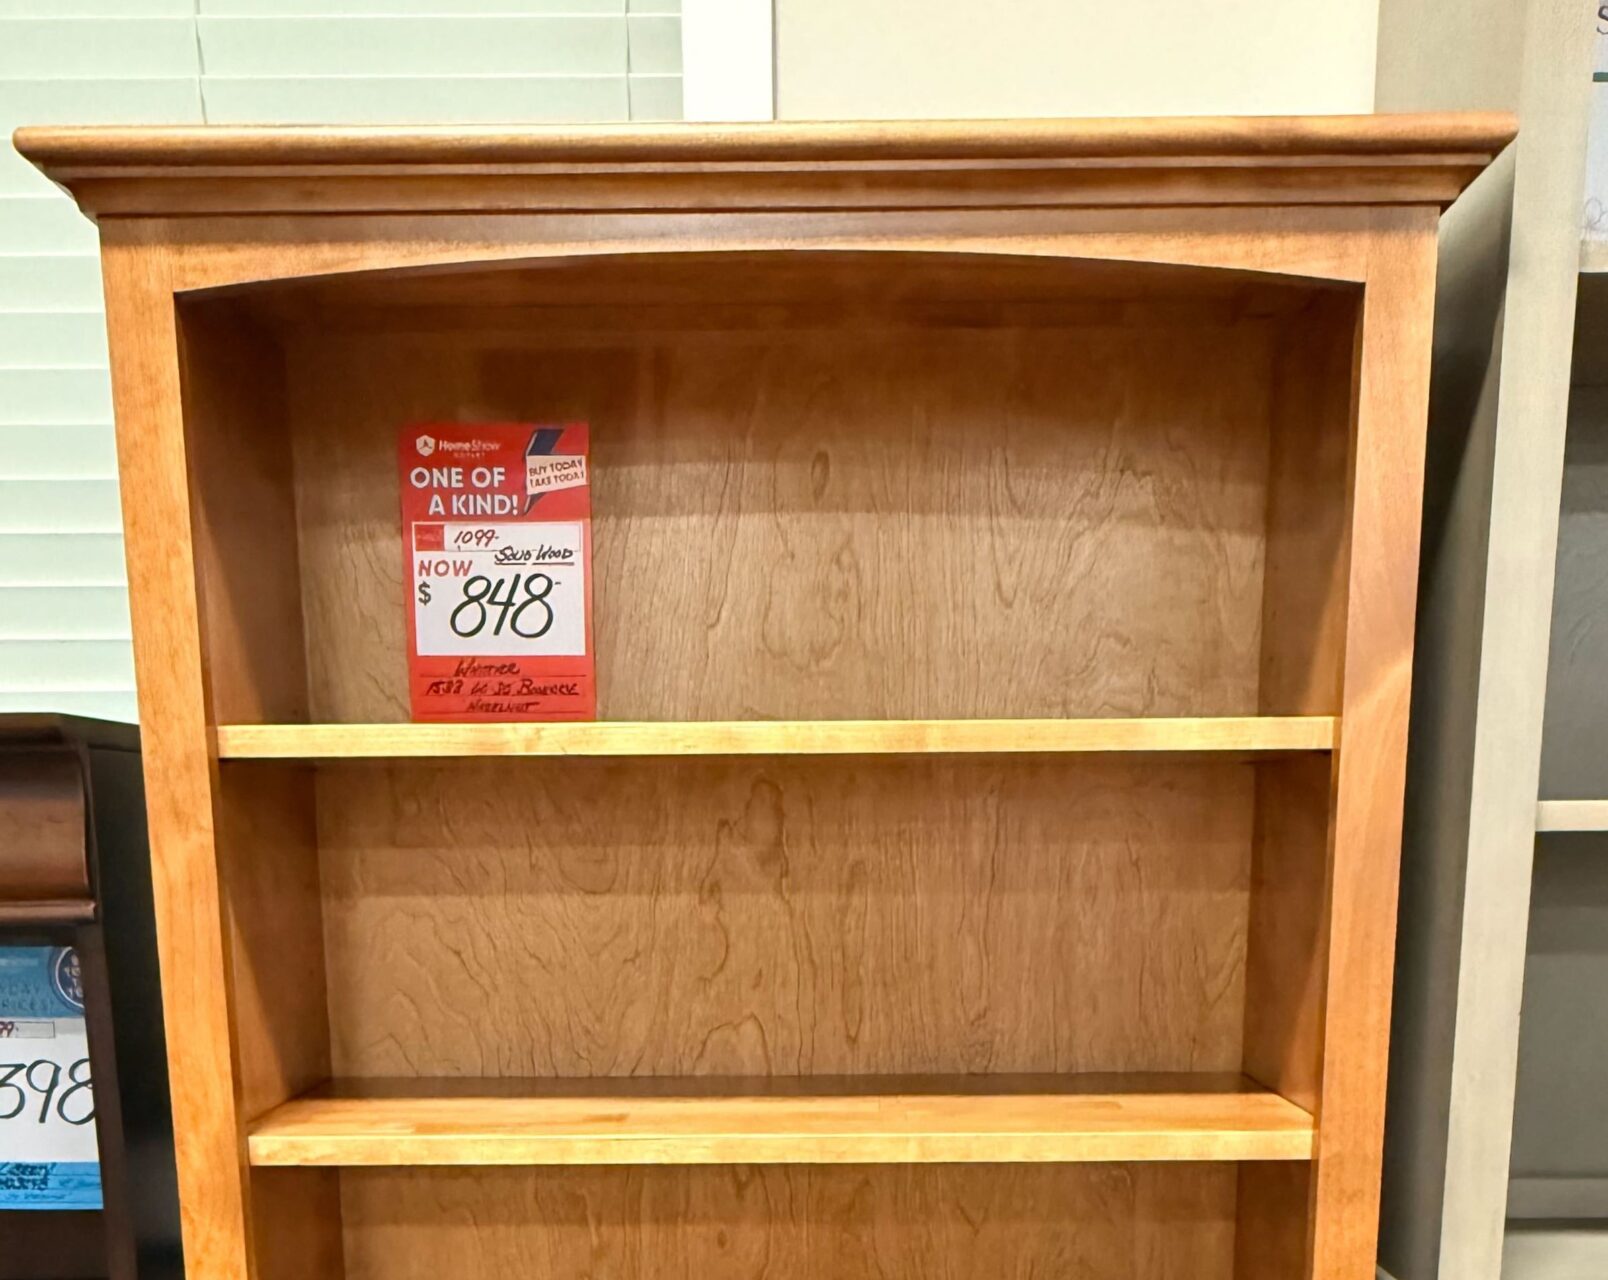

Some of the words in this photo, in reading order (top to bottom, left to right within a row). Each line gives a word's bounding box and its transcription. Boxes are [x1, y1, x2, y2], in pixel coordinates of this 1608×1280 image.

[410, 467, 464, 489] ONE
[471, 467, 506, 488] OF
[529, 465, 548, 478] BUY
[550, 457, 584, 474] TODAY
[529, 476, 551, 489] TAKE
[554, 471, 586, 484] TODAY
[428, 495, 446, 516] A
[452, 494, 519, 516] KIND!
[418, 560, 473, 578] NOW
[418, 581, 432, 606] $
